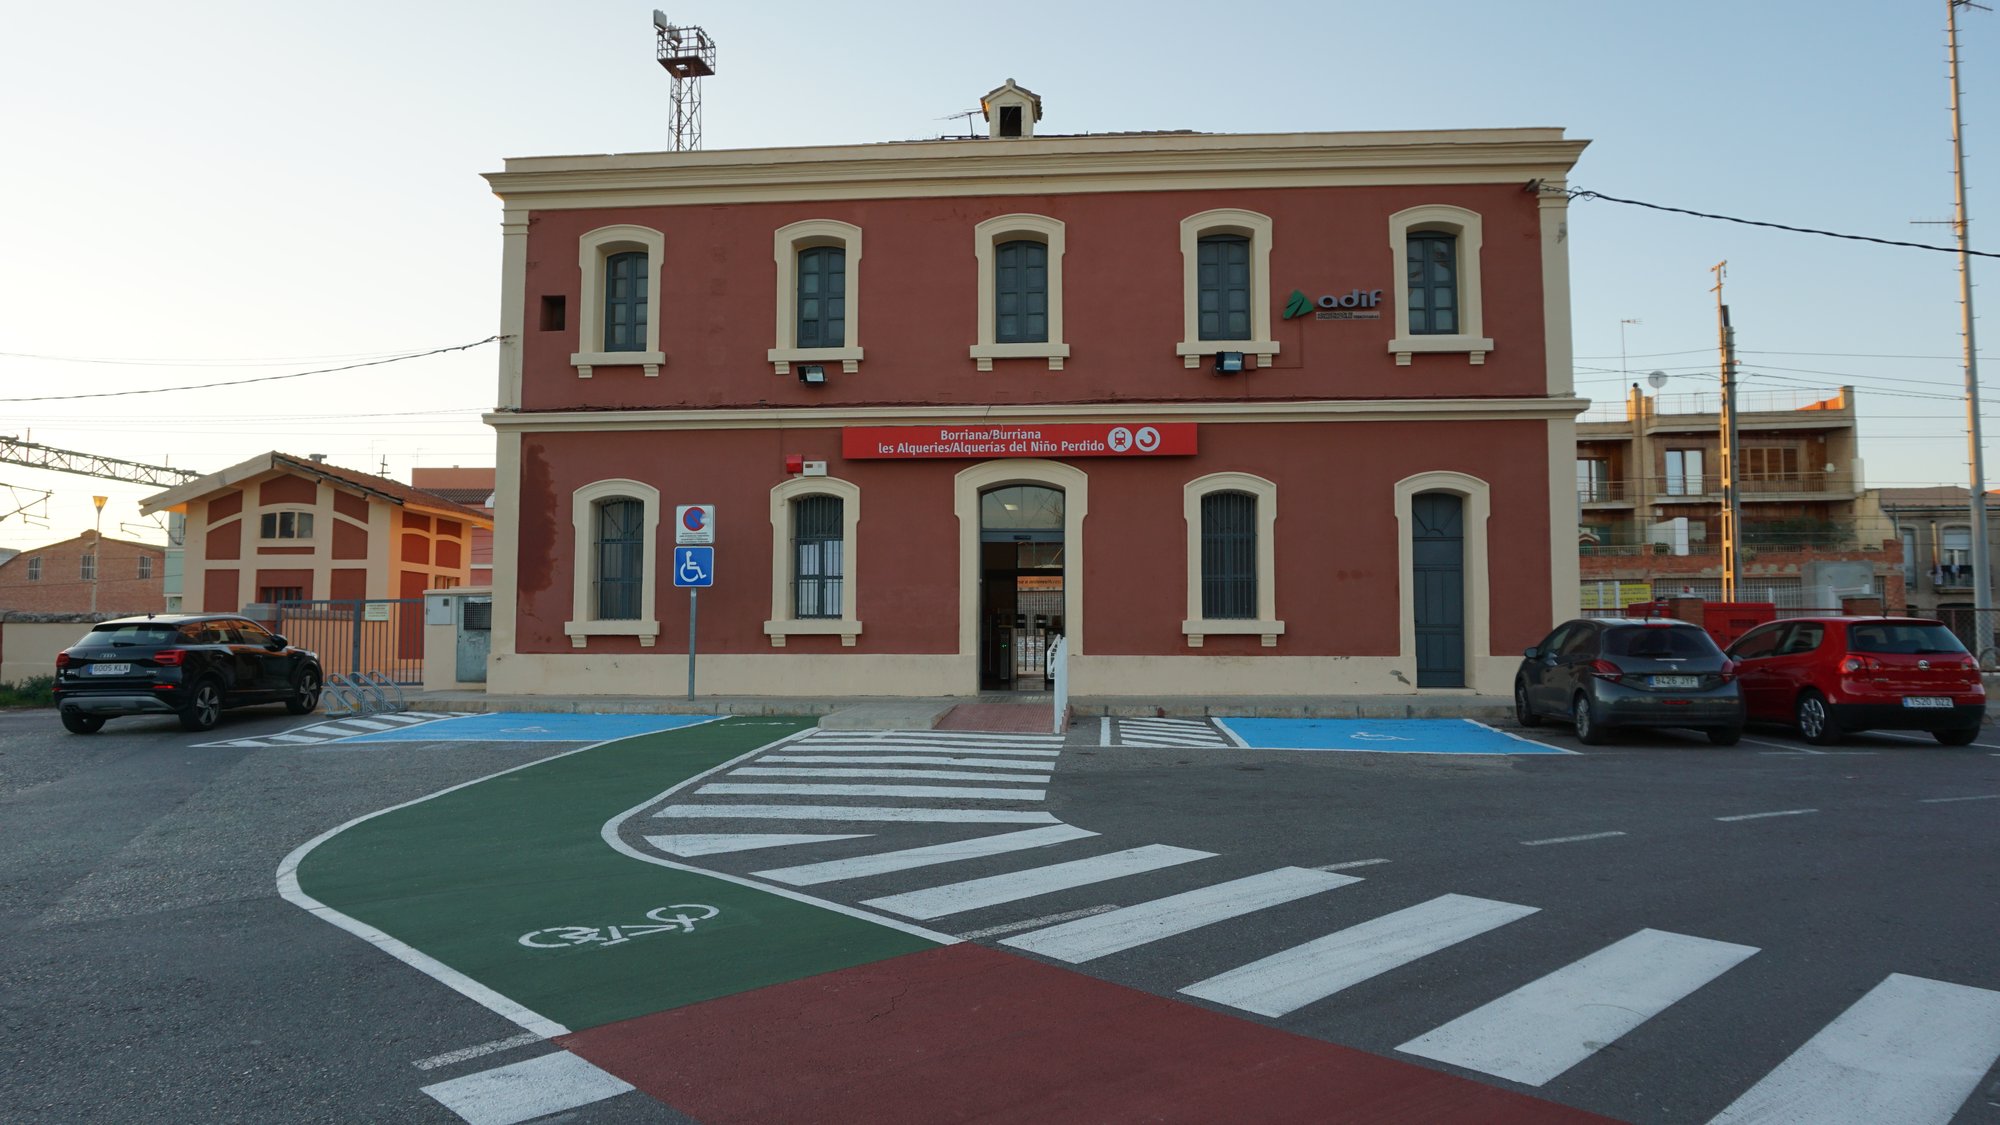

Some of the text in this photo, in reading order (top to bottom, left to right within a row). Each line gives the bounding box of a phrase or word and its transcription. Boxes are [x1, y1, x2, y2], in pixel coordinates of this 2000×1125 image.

[1318, 289, 1382, 308] adif
[941, 429, 1041, 441] Borriana/Burriana
[878, 440, 1105, 456] les Alqueries/Alquerías del Niño Perdido
[114, 664, 129, 672] KLN
[1655, 676, 1677, 685] 9426
